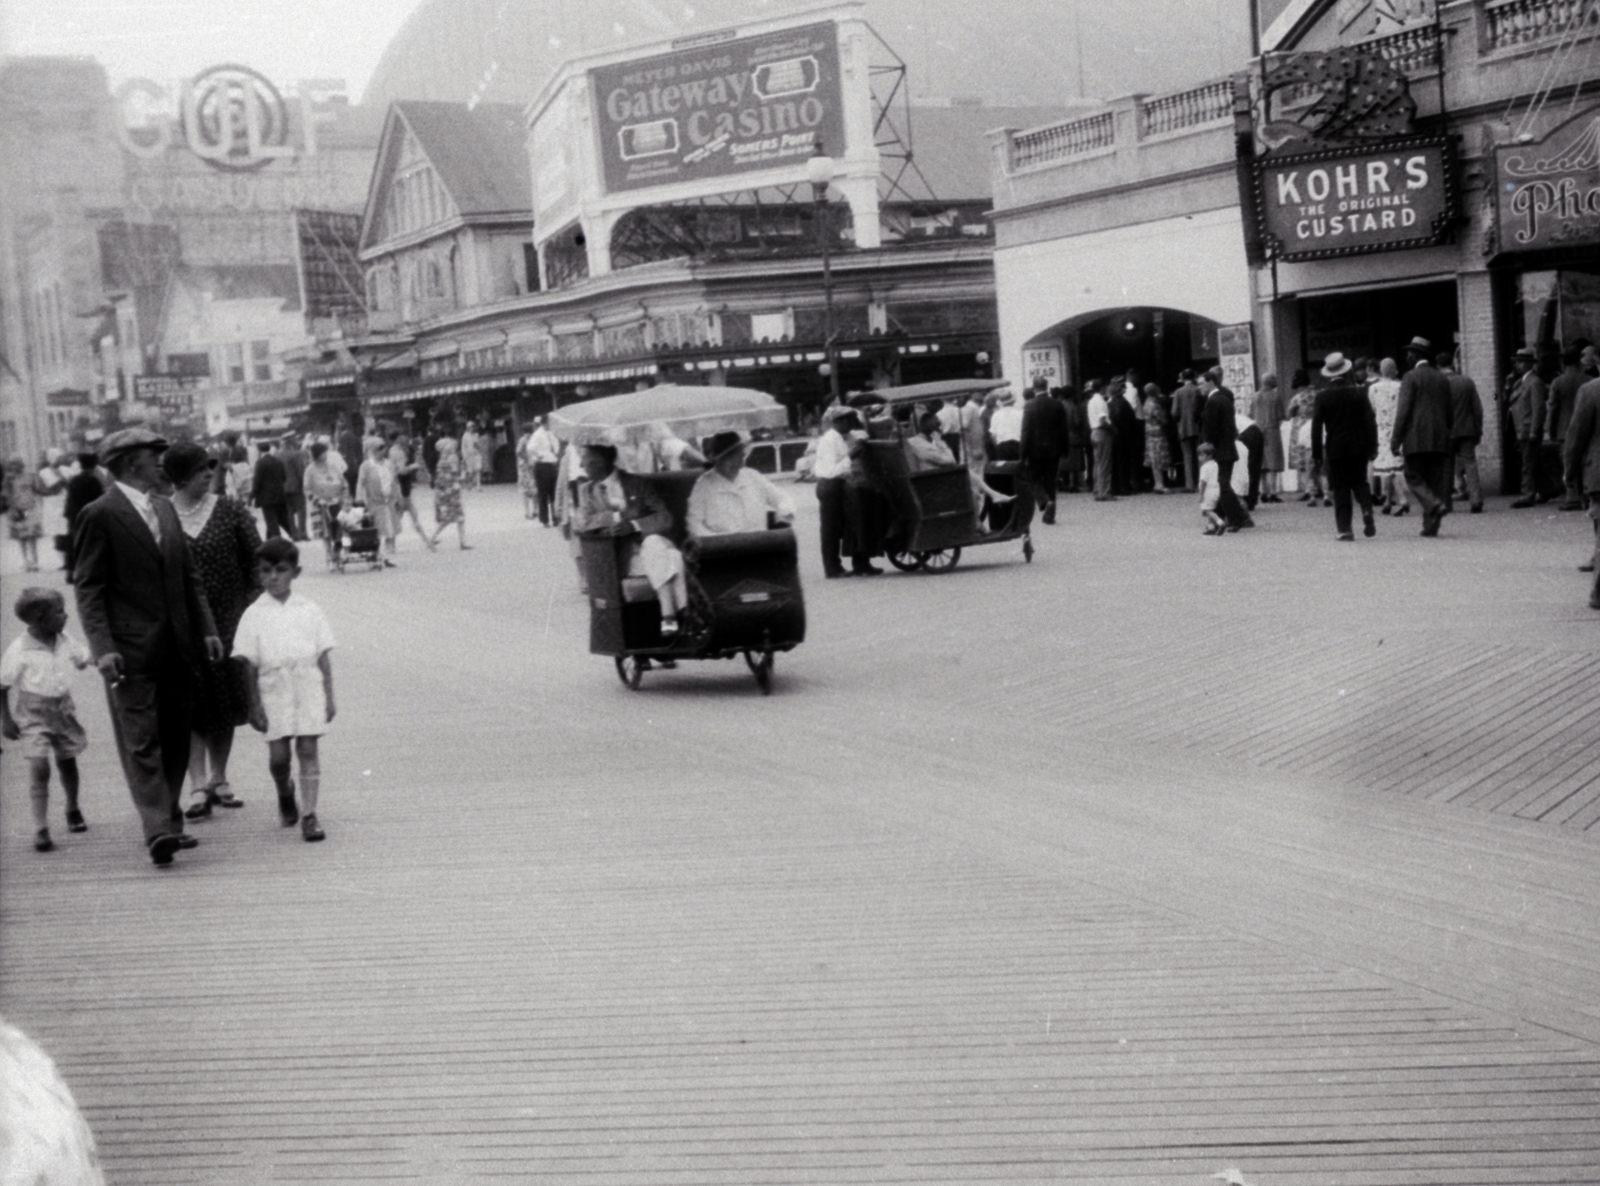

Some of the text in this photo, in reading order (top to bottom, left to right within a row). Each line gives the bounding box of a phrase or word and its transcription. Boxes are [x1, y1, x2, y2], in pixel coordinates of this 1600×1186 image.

[680, 54, 732, 75] DAVIS
[606, 71, 750, 122] Gateway
[687, 97, 824, 146] Casino
[1277, 156, 1428, 205] KOHR'S
[1296, 208, 1416, 239] CUSTARD
[1300, 194, 1410, 216] THE ORIGINAL
